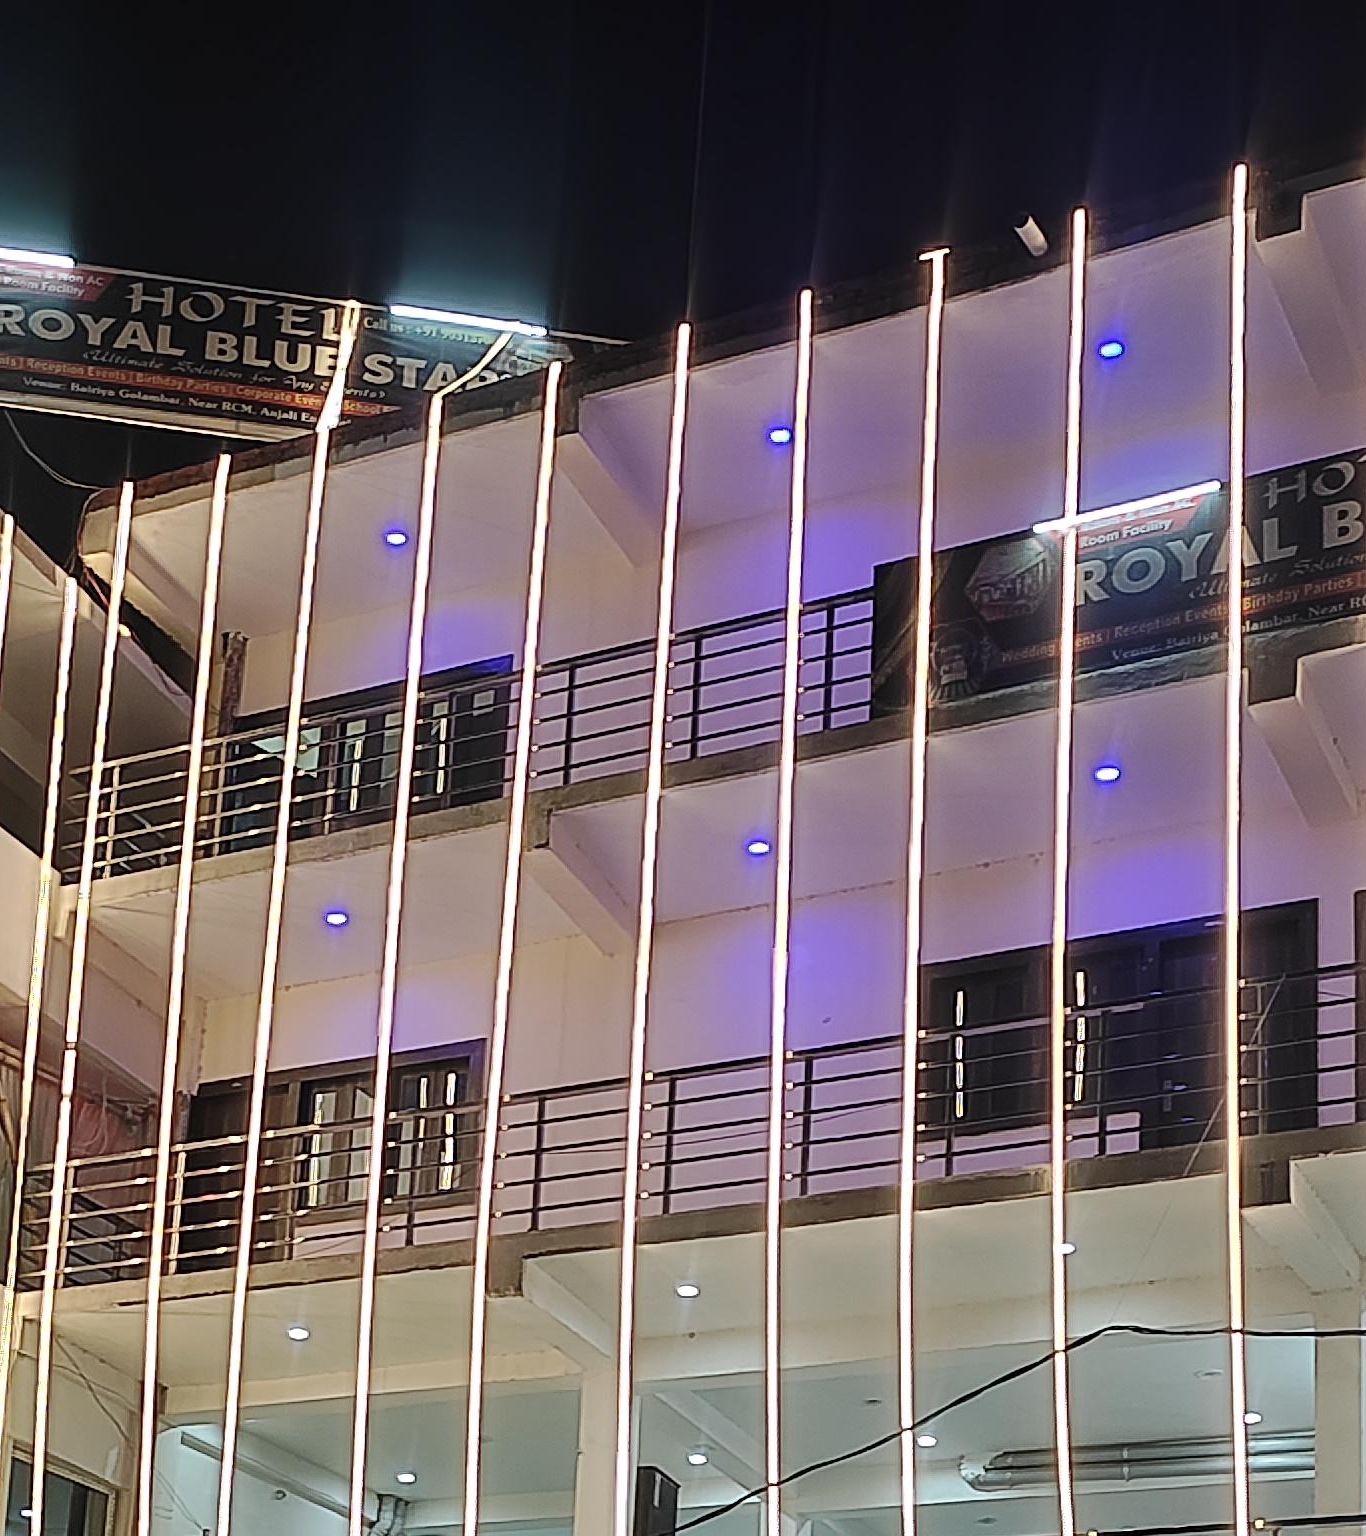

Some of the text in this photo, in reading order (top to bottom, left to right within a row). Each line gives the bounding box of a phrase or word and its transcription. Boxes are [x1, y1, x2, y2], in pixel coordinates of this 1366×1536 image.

[125, 281, 355, 342] HOTEL
[204, 330, 342, 378] BLUE
[26, 357, 85, 377] Reception
[87, 365, 127, 381] Events
[136, 371, 184, 390] Birthday
[186, 379, 228, 394] Parties
[235, 385, 292, 405] Corporate
[295, 393, 334, 411] Even
[188, 396, 219, 411] Near
[1074, 516, 1299, 607] ROYAL
[1002, 642, 1057, 664] Wedding
[1113, 613, 1181, 638] Reception
[1184, 602, 1230, 624] Events
[1242, 587, 1300, 611] Birthday
[1304, 575, 1354, 596] Parties
